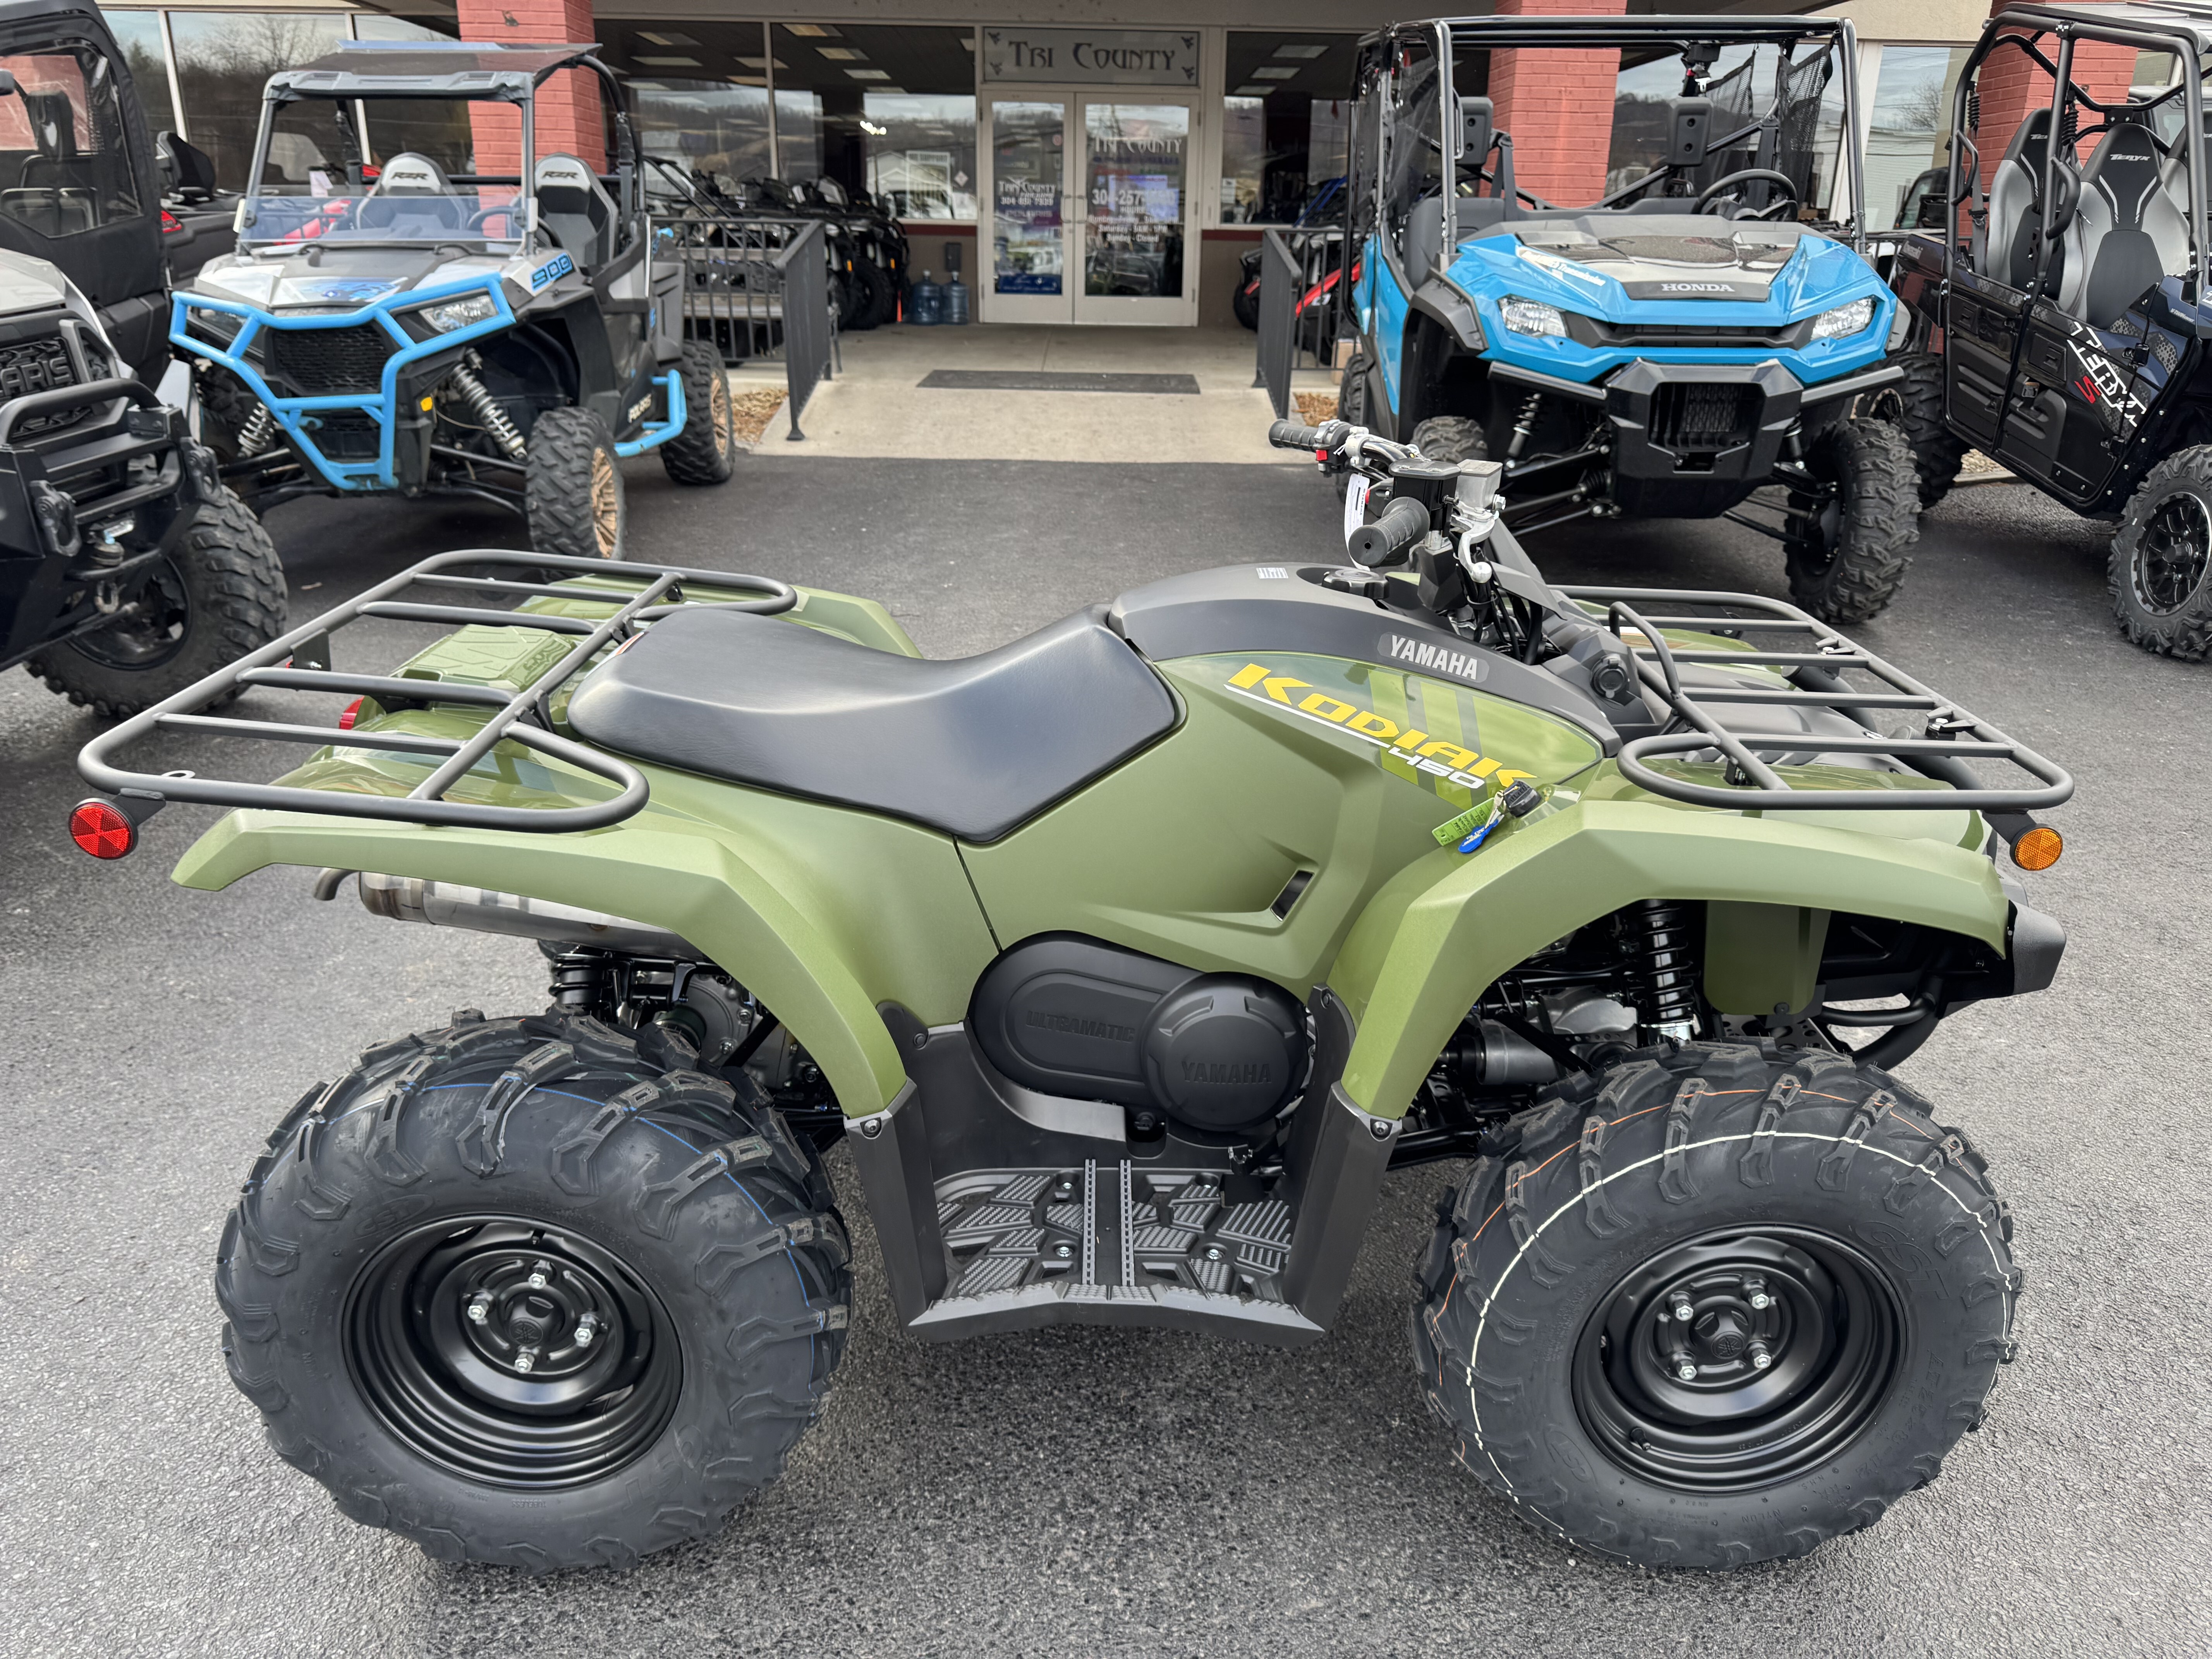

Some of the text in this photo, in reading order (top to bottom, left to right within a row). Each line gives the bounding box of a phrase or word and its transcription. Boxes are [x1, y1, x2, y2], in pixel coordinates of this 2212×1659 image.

[1009, 41, 1175, 71] TRI COUNTY
[392, 172, 429, 180] RZR
[543, 171, 578, 179] RZR
[531, 253, 574, 291] 900
[1661, 283, 1735, 292] HONDA
[0, 356, 70, 397] ARIS
[1390, 635, 1478, 680] YAMAHA
[1228, 663, 1537, 788] KODIAK
[1388, 747, 1486, 789] 450
[1025, 1011, 1135, 1044] ULTRAMATIC
[1182, 1060, 1272, 1084] YAMAHA
[1740, 1507, 1782, 1524] NYLON
